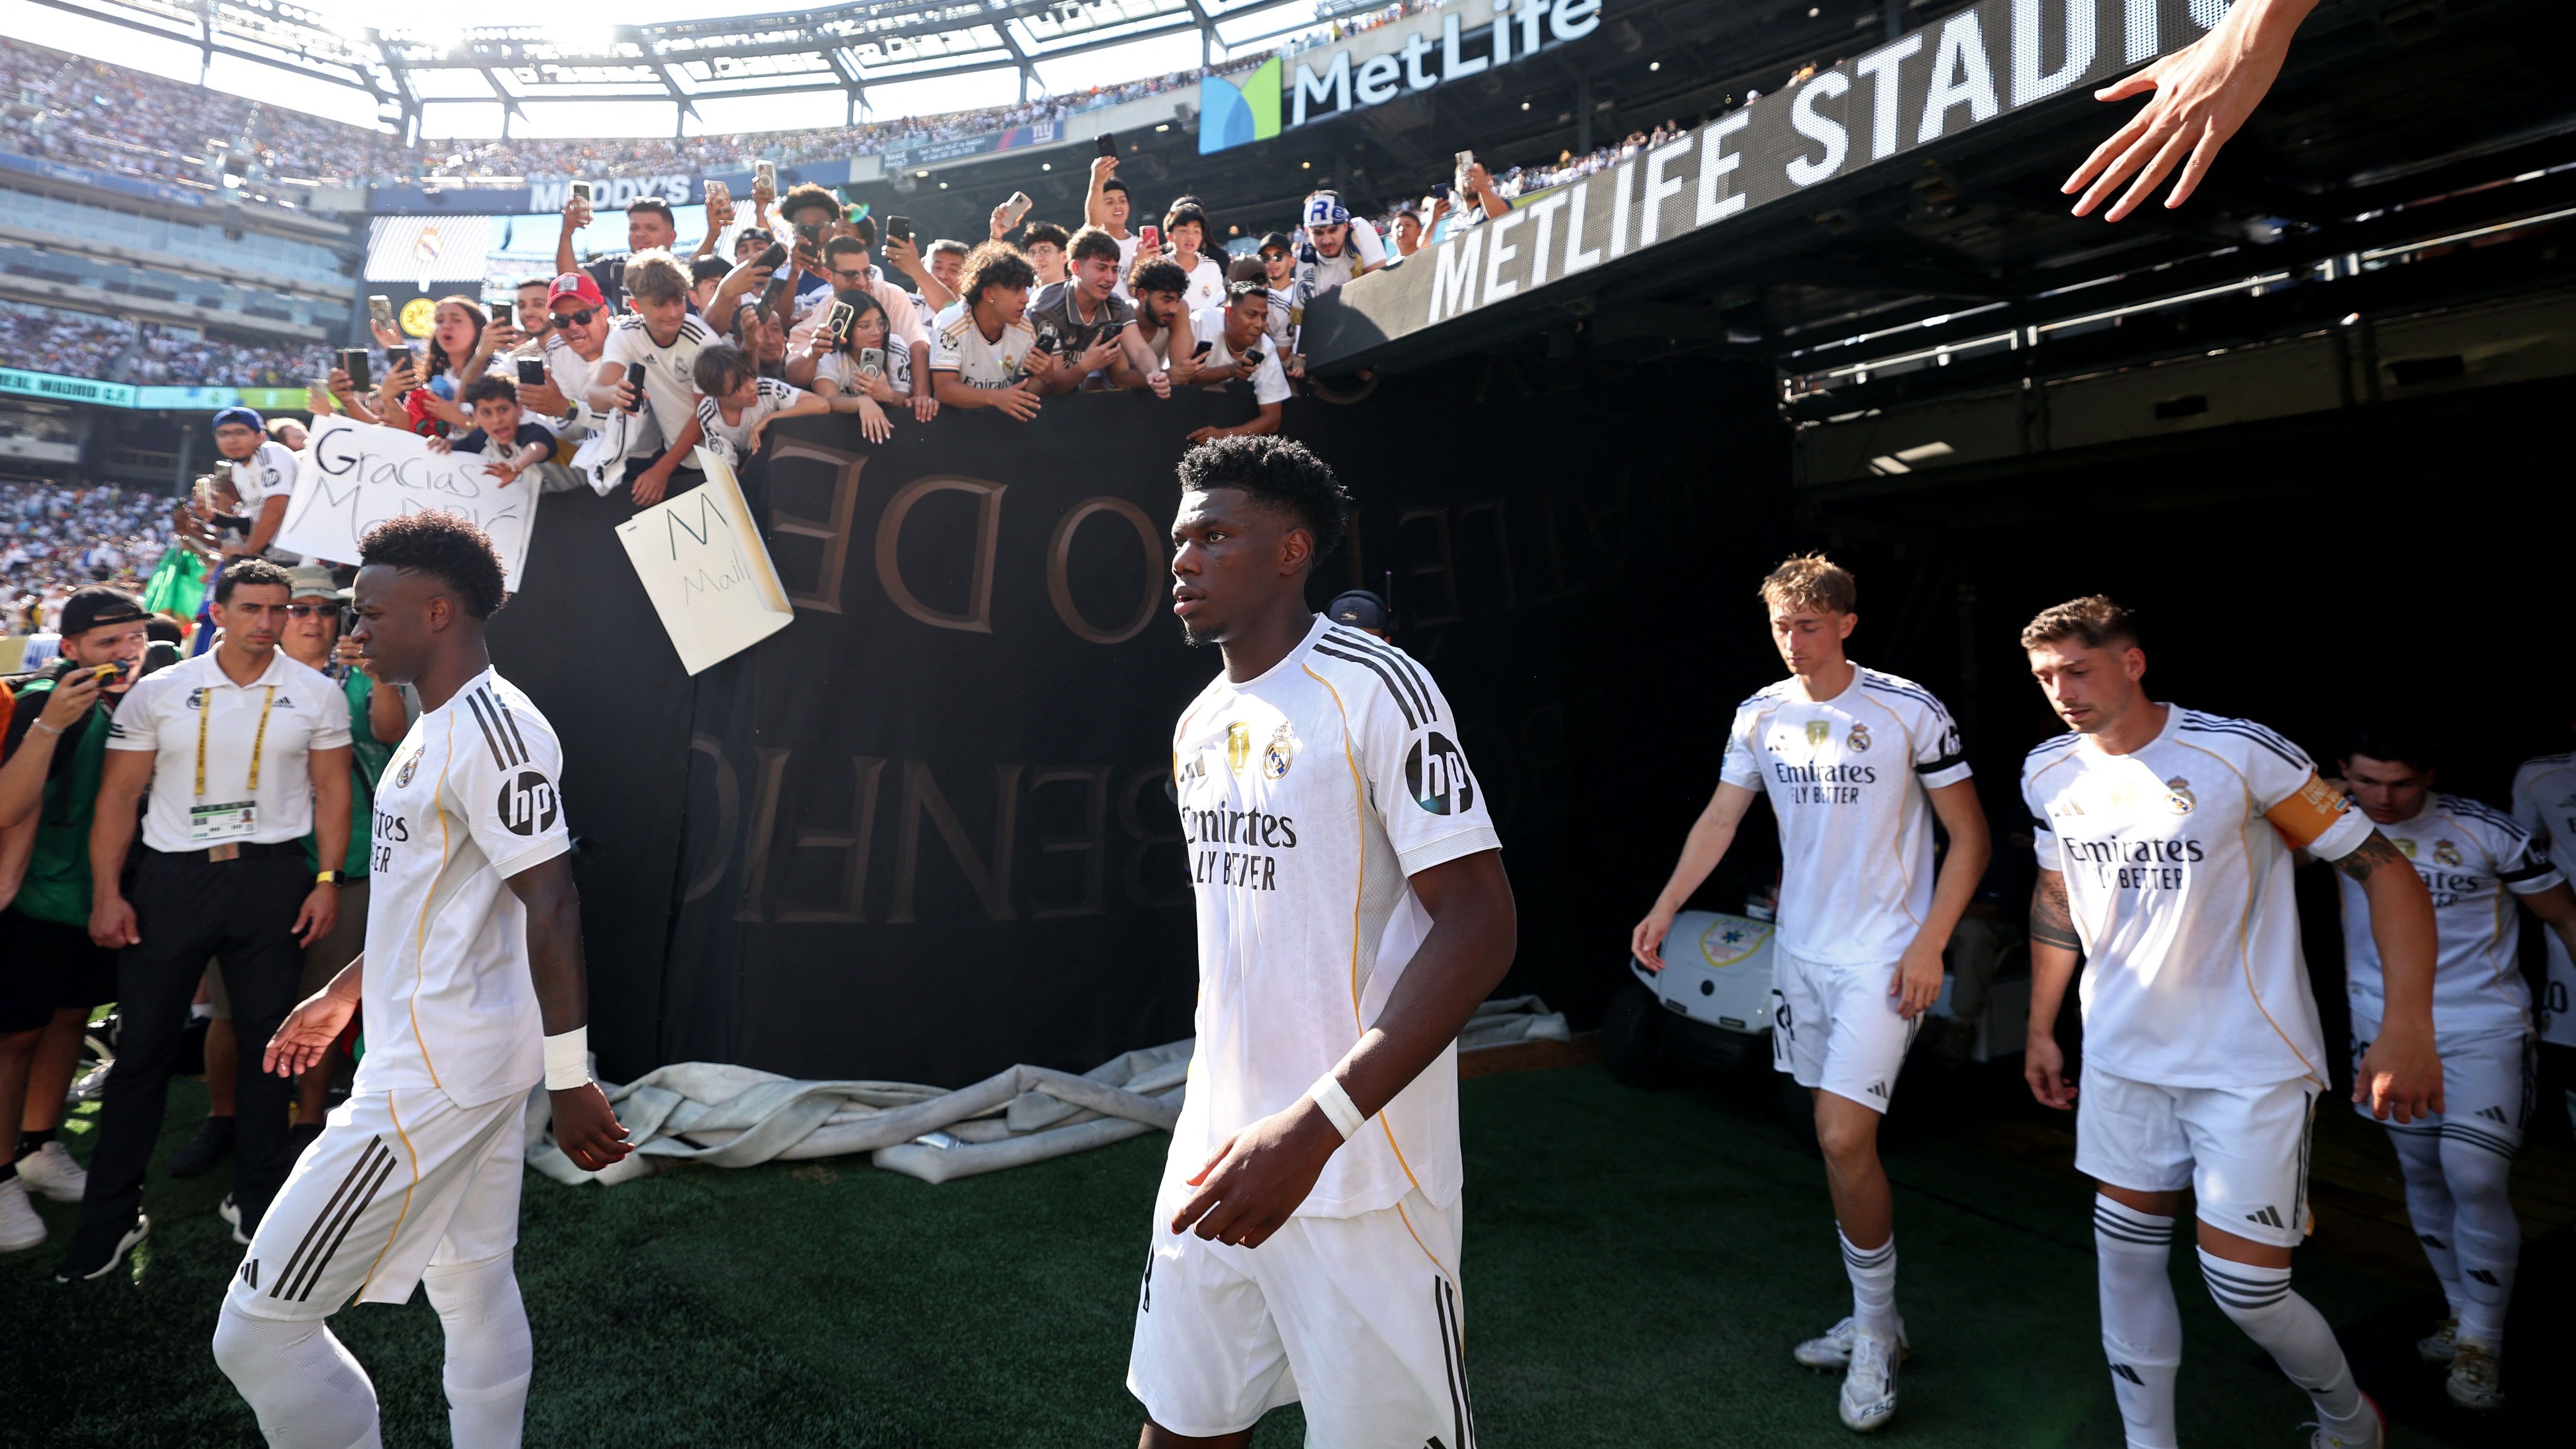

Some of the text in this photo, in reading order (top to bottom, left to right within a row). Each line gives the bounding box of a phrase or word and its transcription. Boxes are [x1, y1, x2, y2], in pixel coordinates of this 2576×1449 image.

[1293, 0, 1602, 126] MetLife
[1428, 0, 2230, 325] METLIFE STADI
[316, 427, 480, 498] Gracias
[1419, 731, 1467, 815] hp
[1776, 760, 1876, 783] Emirates
[508, 772, 551, 836] hp
[1182, 800, 1296, 848] Emirtes
[1197, 851, 1276, 891] LY BETER
[2062, 835, 2205, 862] Emirates
[2118, 868, 2183, 889] BETTER
